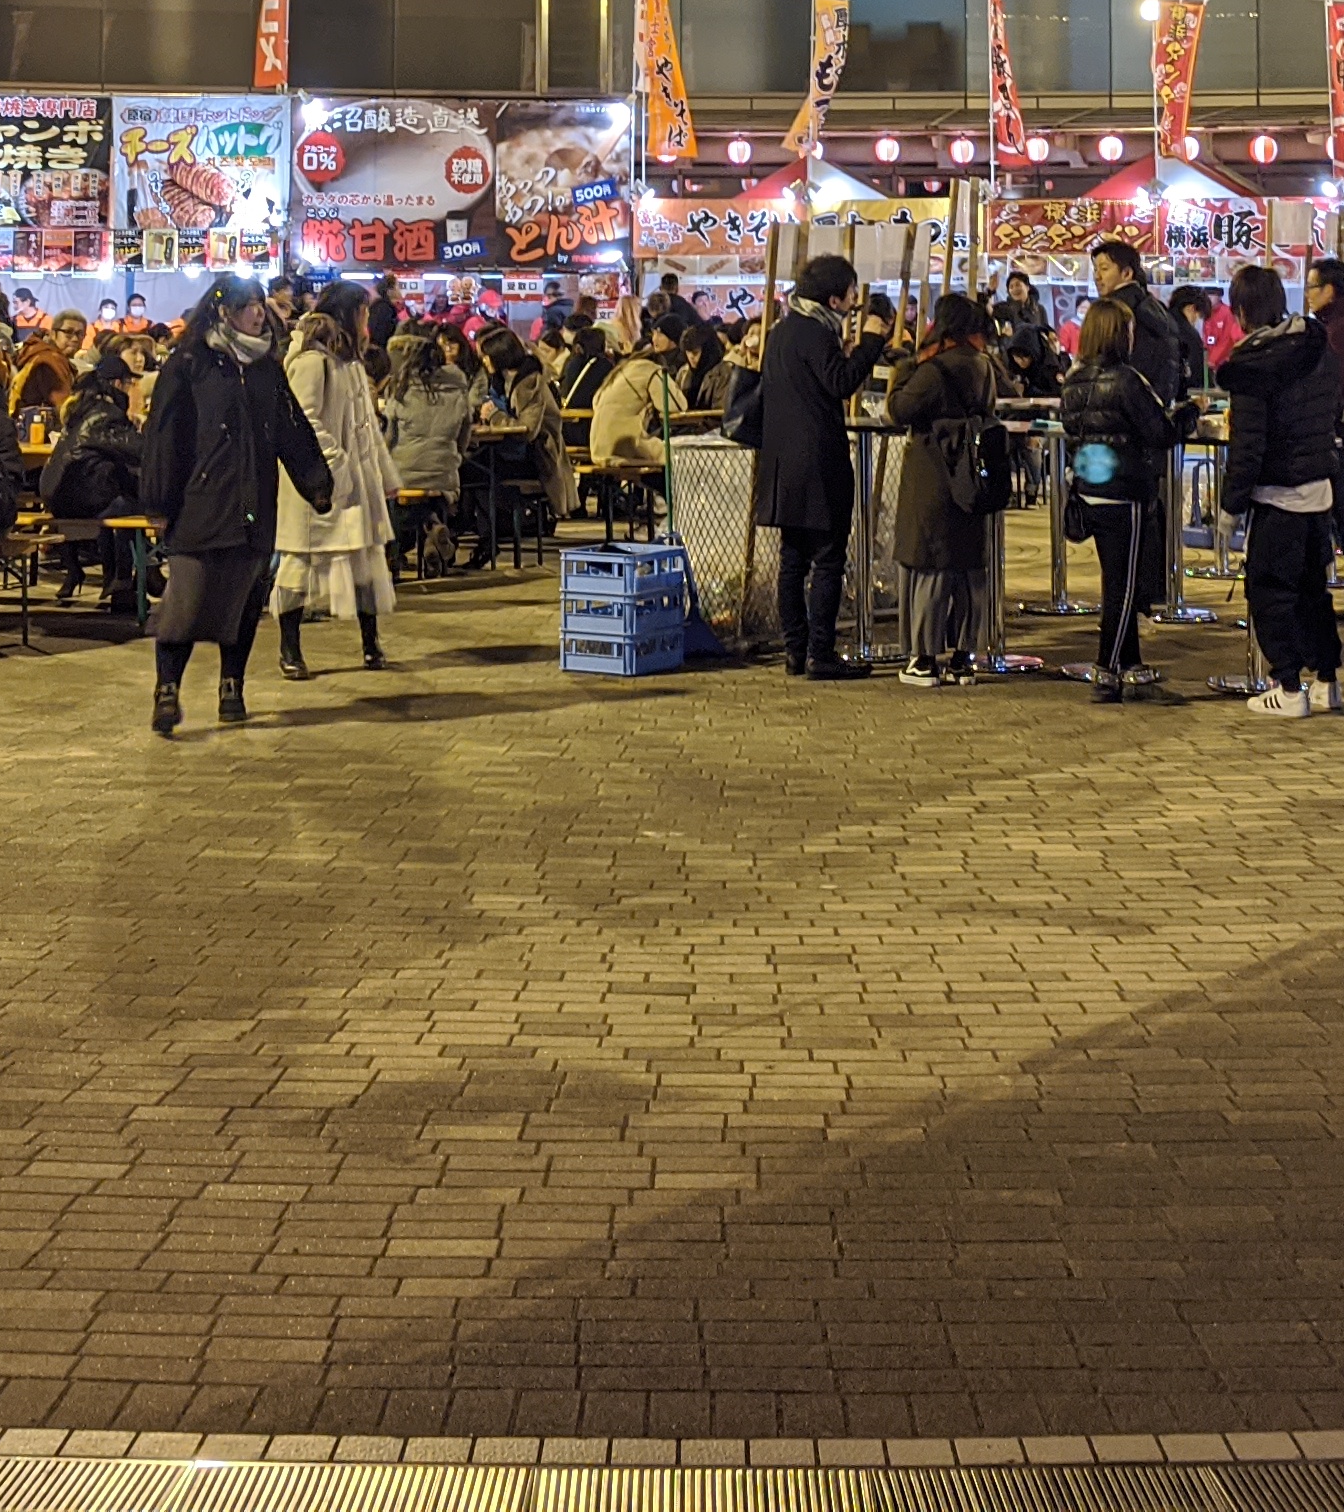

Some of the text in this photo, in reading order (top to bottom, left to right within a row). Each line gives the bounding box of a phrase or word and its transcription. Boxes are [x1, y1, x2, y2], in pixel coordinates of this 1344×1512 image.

[127, 109, 153, 122] 原宿
[159, 106, 283, 124] 韓国ホットドッグ
[304, 104, 488, 135] 沼醸造直送
[303, 144, 338, 154] アルコール
[302, 153, 338, 172] 0%
[451, 158, 483, 174] 砂糖
[450, 173, 483, 185] 不使用
[302, 193, 436, 208] カラダの芯から温ったまる
[575, 183, 613, 203] 500円
[1043, 201, 1102, 223] 横浜
[506, 199, 620, 263] とん汁
[685, 208, 800, 248] やきそ
[1165, 225, 1210, 249] 横浜
[442, 242, 482, 261] 300円
[557, 253, 569, 264] by
